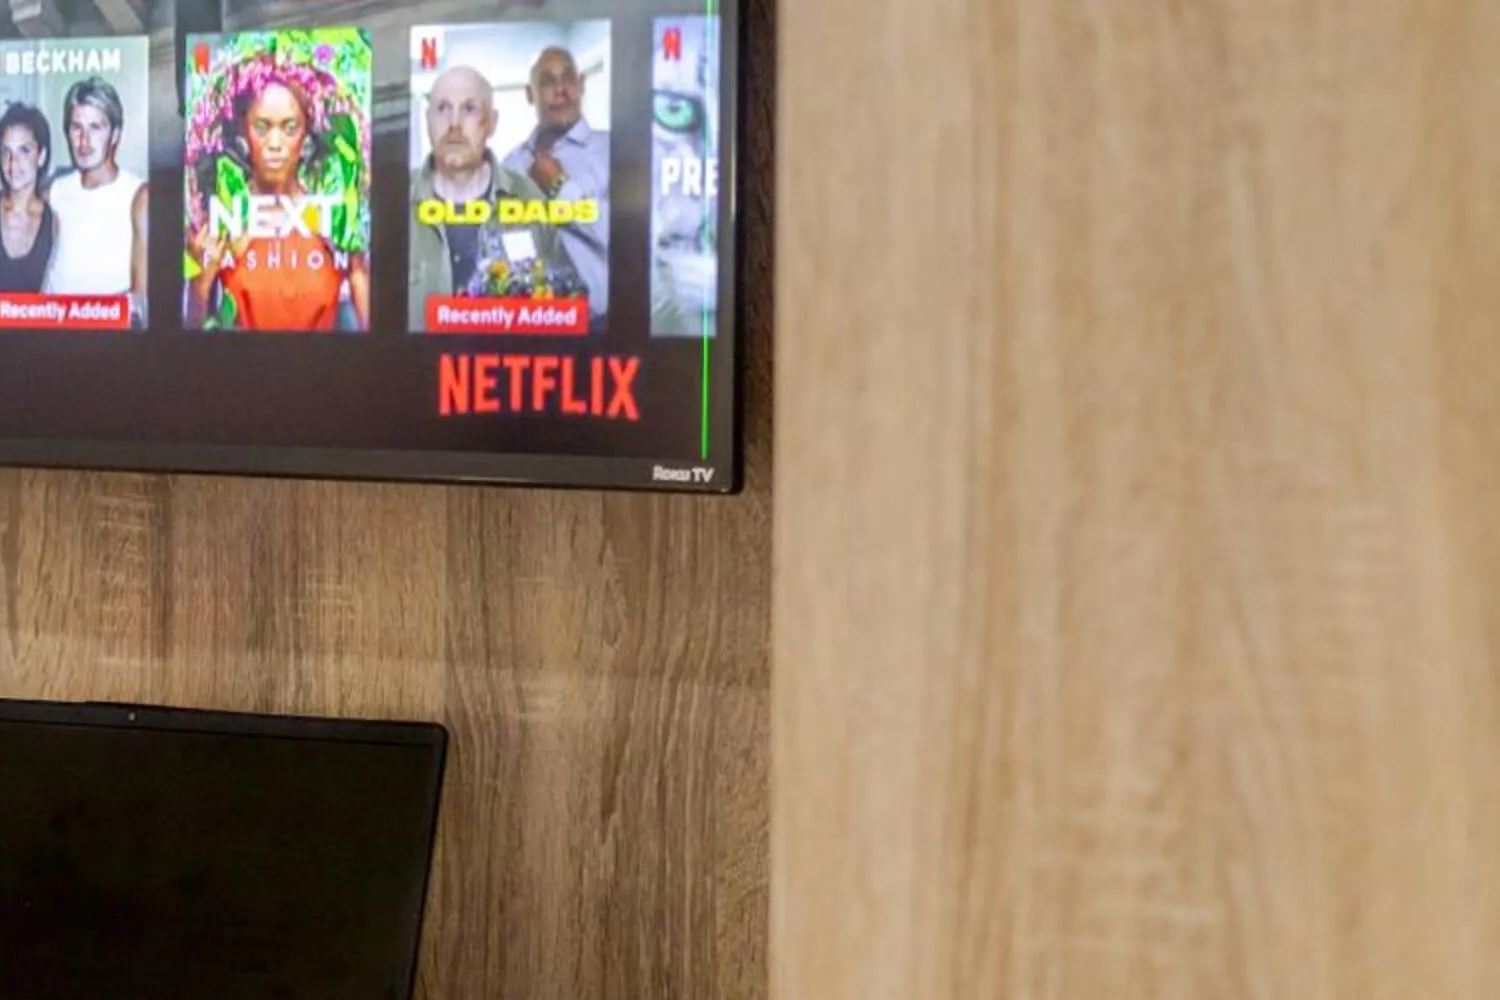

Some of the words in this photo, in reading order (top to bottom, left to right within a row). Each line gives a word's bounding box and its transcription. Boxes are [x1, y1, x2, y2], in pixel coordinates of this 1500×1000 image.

[5, 49, 121, 75] BECKHAM
[660, 158, 718, 196] PRE
[209, 195, 343, 238] NEXT
[418, 200, 492, 224] OLD
[499, 199, 601, 224] DADS
[203, 251, 349, 270] FASHION
[0, 301, 68, 321] Recently
[70, 304, 121, 319] Added
[437, 304, 513, 327] Recently
[517, 307, 578, 326] Added
[438, 354, 640, 421] NETFLIX
[692, 467, 714, 483] TV
